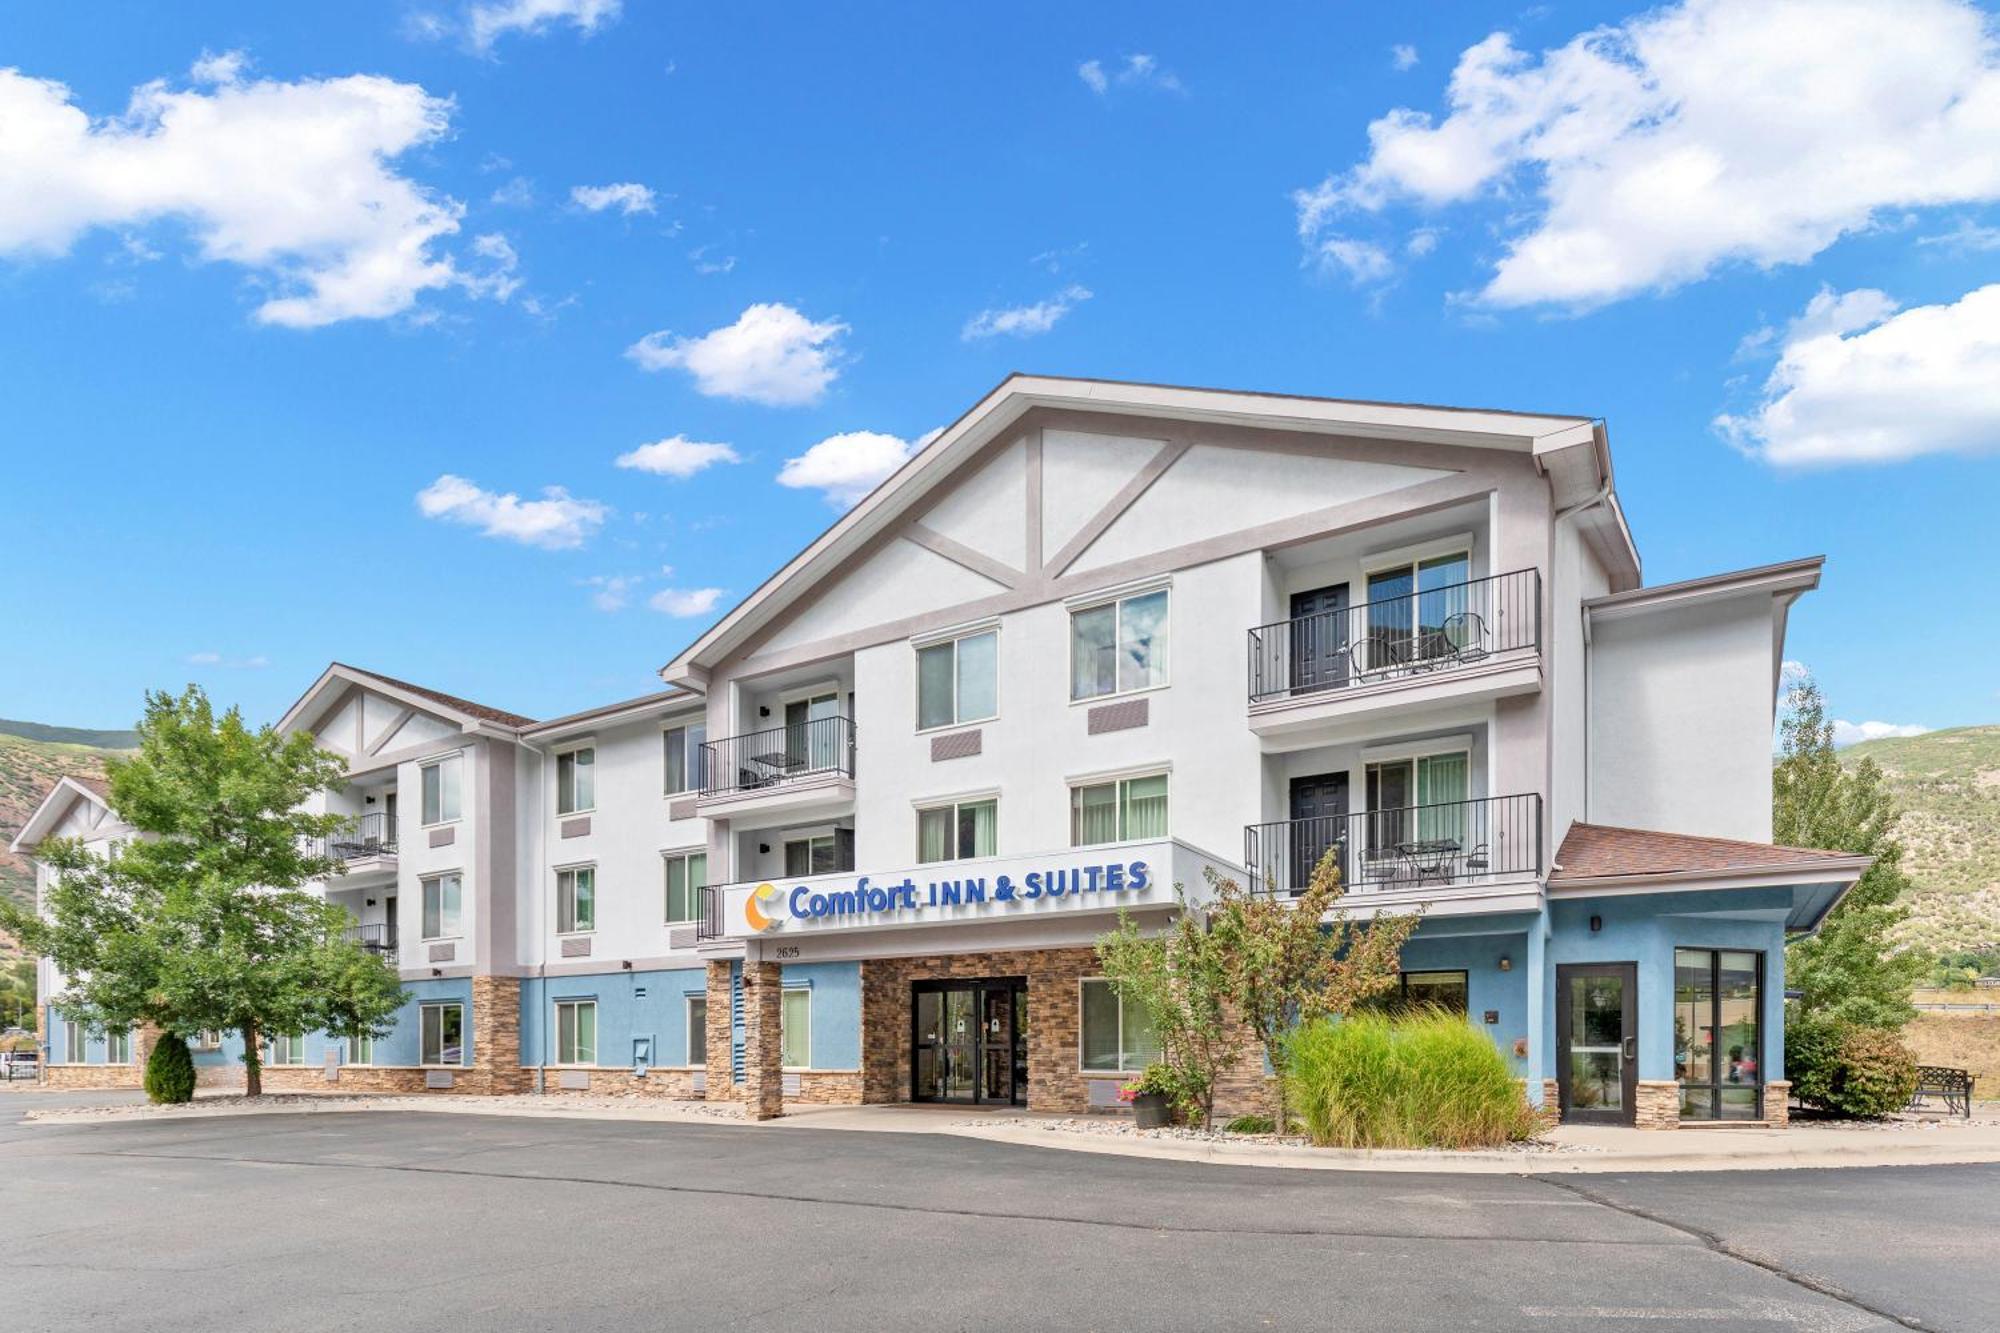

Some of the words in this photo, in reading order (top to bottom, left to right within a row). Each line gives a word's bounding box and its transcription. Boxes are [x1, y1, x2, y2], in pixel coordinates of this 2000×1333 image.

[788, 877, 916, 918] Comfort
[930, 879, 985, 906] INN
[995, 875, 1015, 901] &
[1025, 861, 1147, 898] SUITES
[776, 946, 800, 959] 2625
